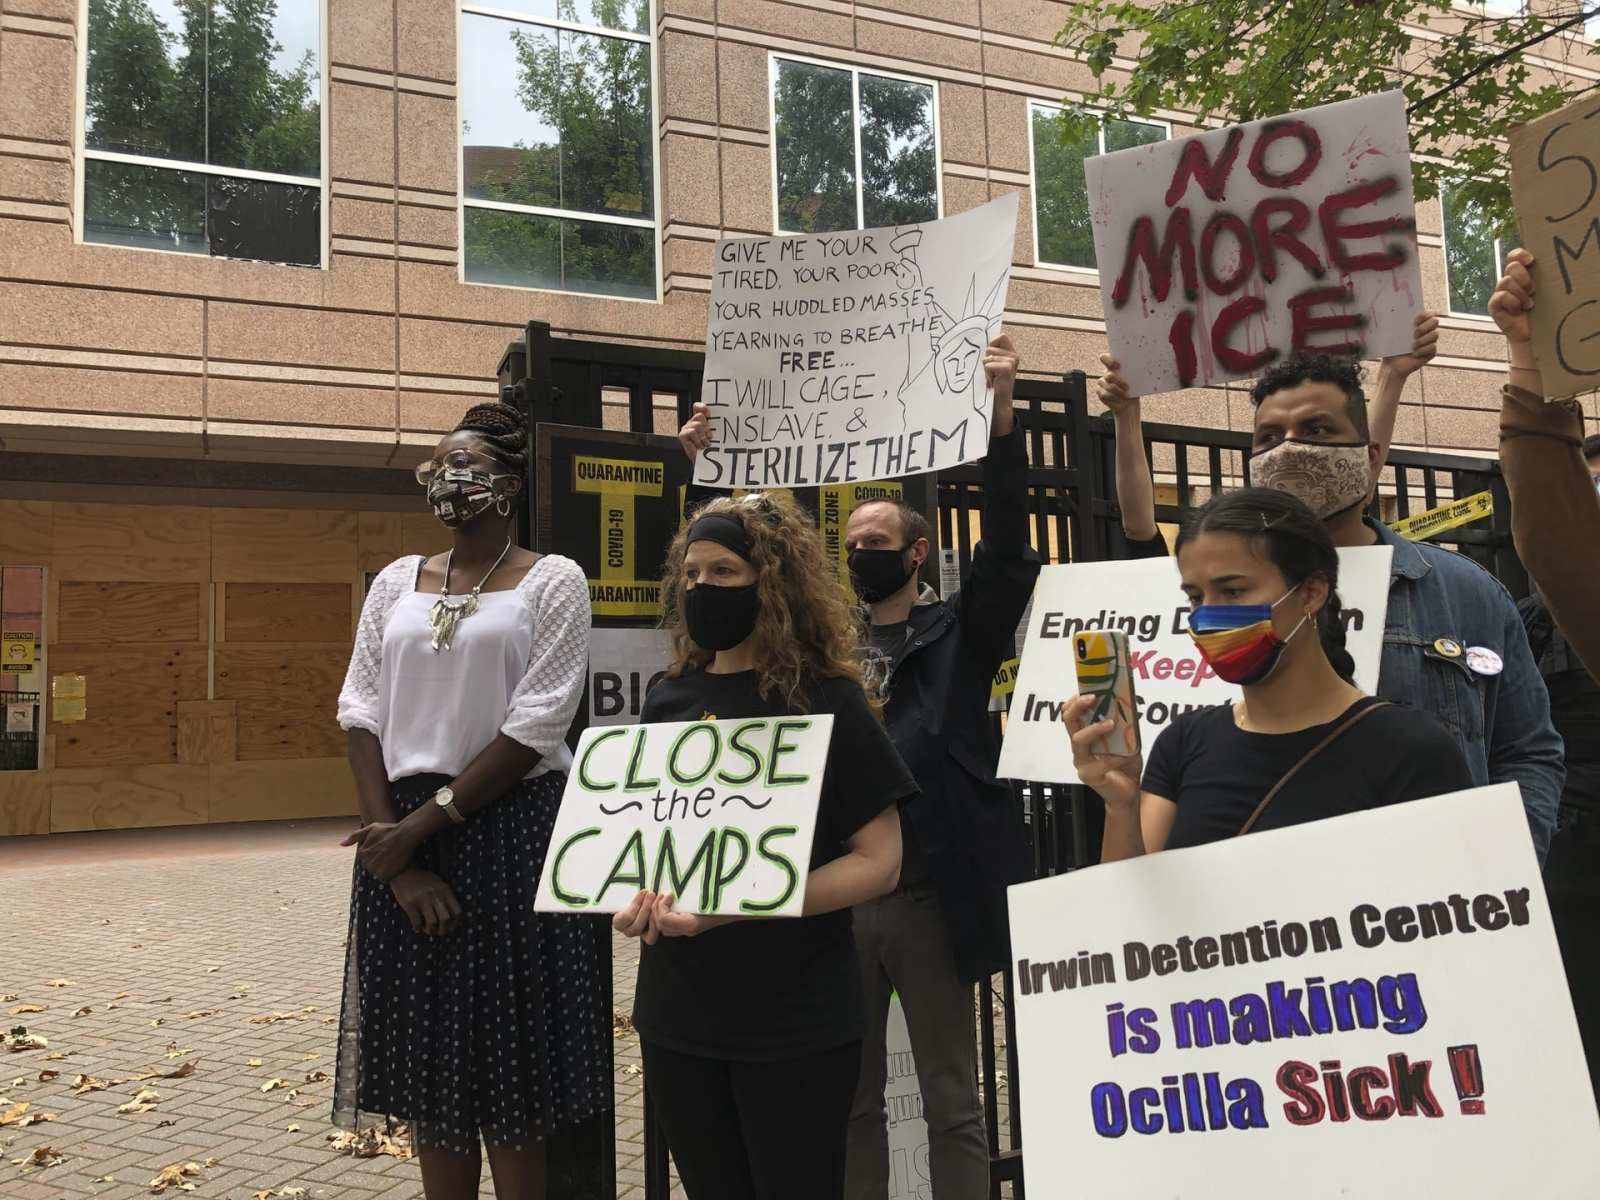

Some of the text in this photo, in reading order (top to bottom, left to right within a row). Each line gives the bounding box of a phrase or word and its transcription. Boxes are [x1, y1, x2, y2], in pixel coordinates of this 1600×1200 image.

[1164, 119, 1322, 207] NO
[721, 235, 878, 264] GIVE ME YOUR
[1111, 178, 1416, 309] MORE
[793, 265, 840, 284] YOUR
[714, 286, 935, 321] YOUR HUDDLED MASSES
[711, 315, 944, 352] YEARNING TO BREATHE
[1168, 286, 1371, 388] ICE
[779, 351, 856, 374] FREE...
[706, 373, 888, 410] I WILL CAGE,
[845, 407, 869, 433] &
[697, 418, 969, 486] STERILIZE THEM
[577, 461, 662, 484] QUARANTINE
[825, 491, 839, 525] ZONE
[1408, 502, 1472, 534] QUARANTINE ZONE
[608, 509, 624, 568] COVID-19
[1039, 609, 1161, 643] Ending
[578, 720, 812, 793] CLOSE
[652, 787, 715, 822] the
[551, 825, 800, 912] CAMPS
[1017, 887, 1531, 996] Irwin Detention Center
[1106, 972, 1428, 1058] is making
[1090, 1044, 1486, 1138] Ocilla Sick !
